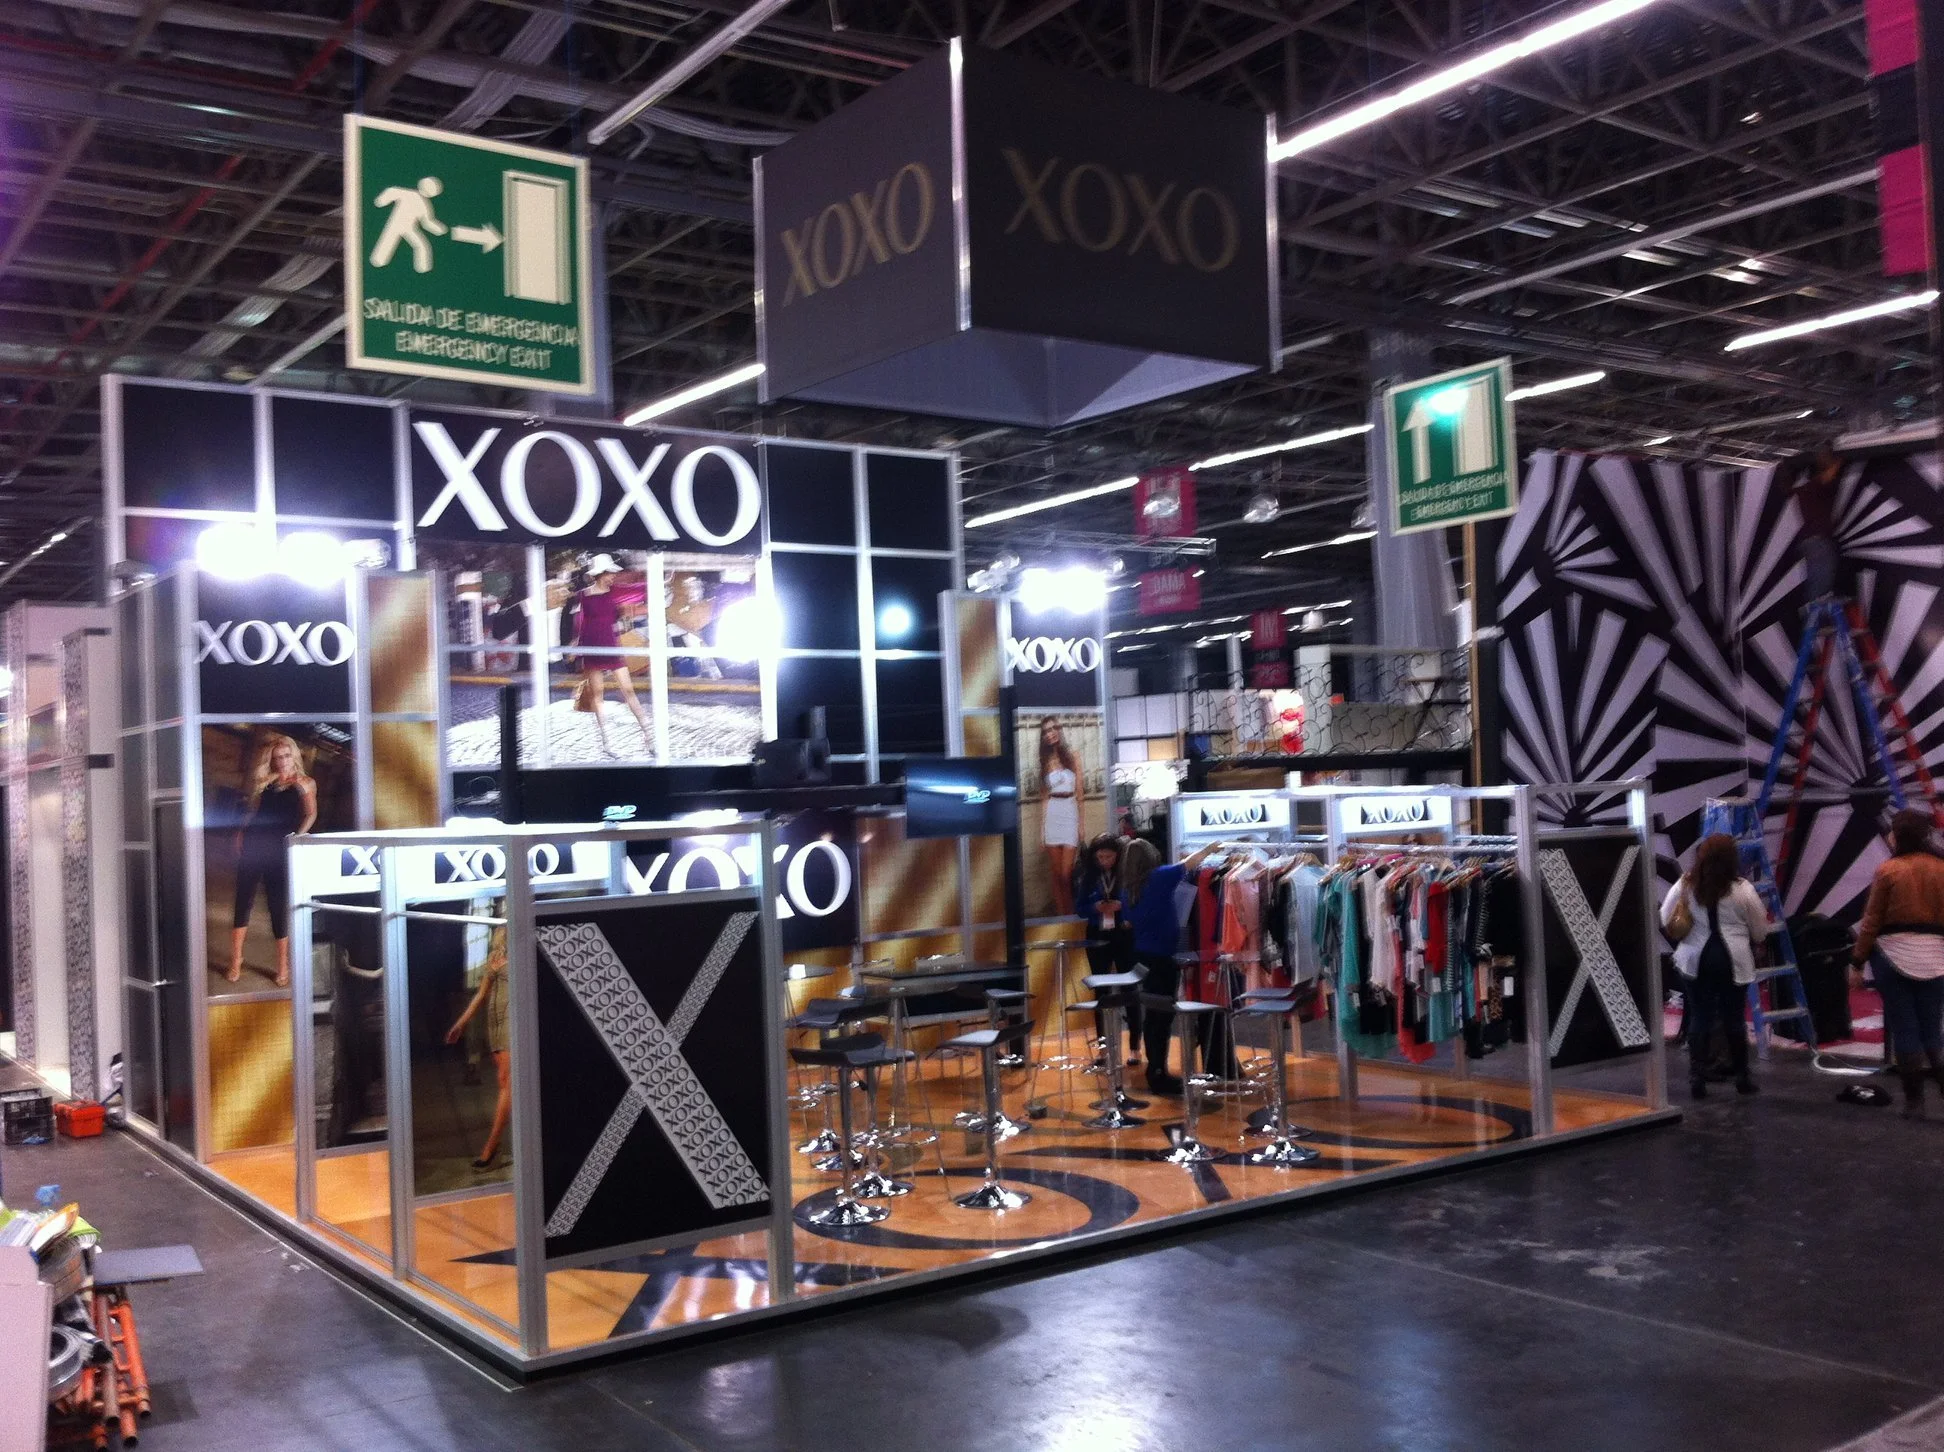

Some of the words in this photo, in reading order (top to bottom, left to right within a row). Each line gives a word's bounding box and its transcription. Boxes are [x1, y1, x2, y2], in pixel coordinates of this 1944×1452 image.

[782, 162, 935, 307] XOXO
[1001, 148, 1242, 273] XOXO
[363, 298, 436, 327] SALIDA
[435, 307, 465, 331] DE
[465, 311, 579, 347] EMERGENCIA
[395, 330, 509, 365] EMERGENCY
[509, 347, 553, 370] EXIT
[412, 421, 762, 547] XOXO
[187, 620, 356, 667] XOXO
[1004, 636, 1101, 673] XOXO
[444, 844, 560, 882] XOO
